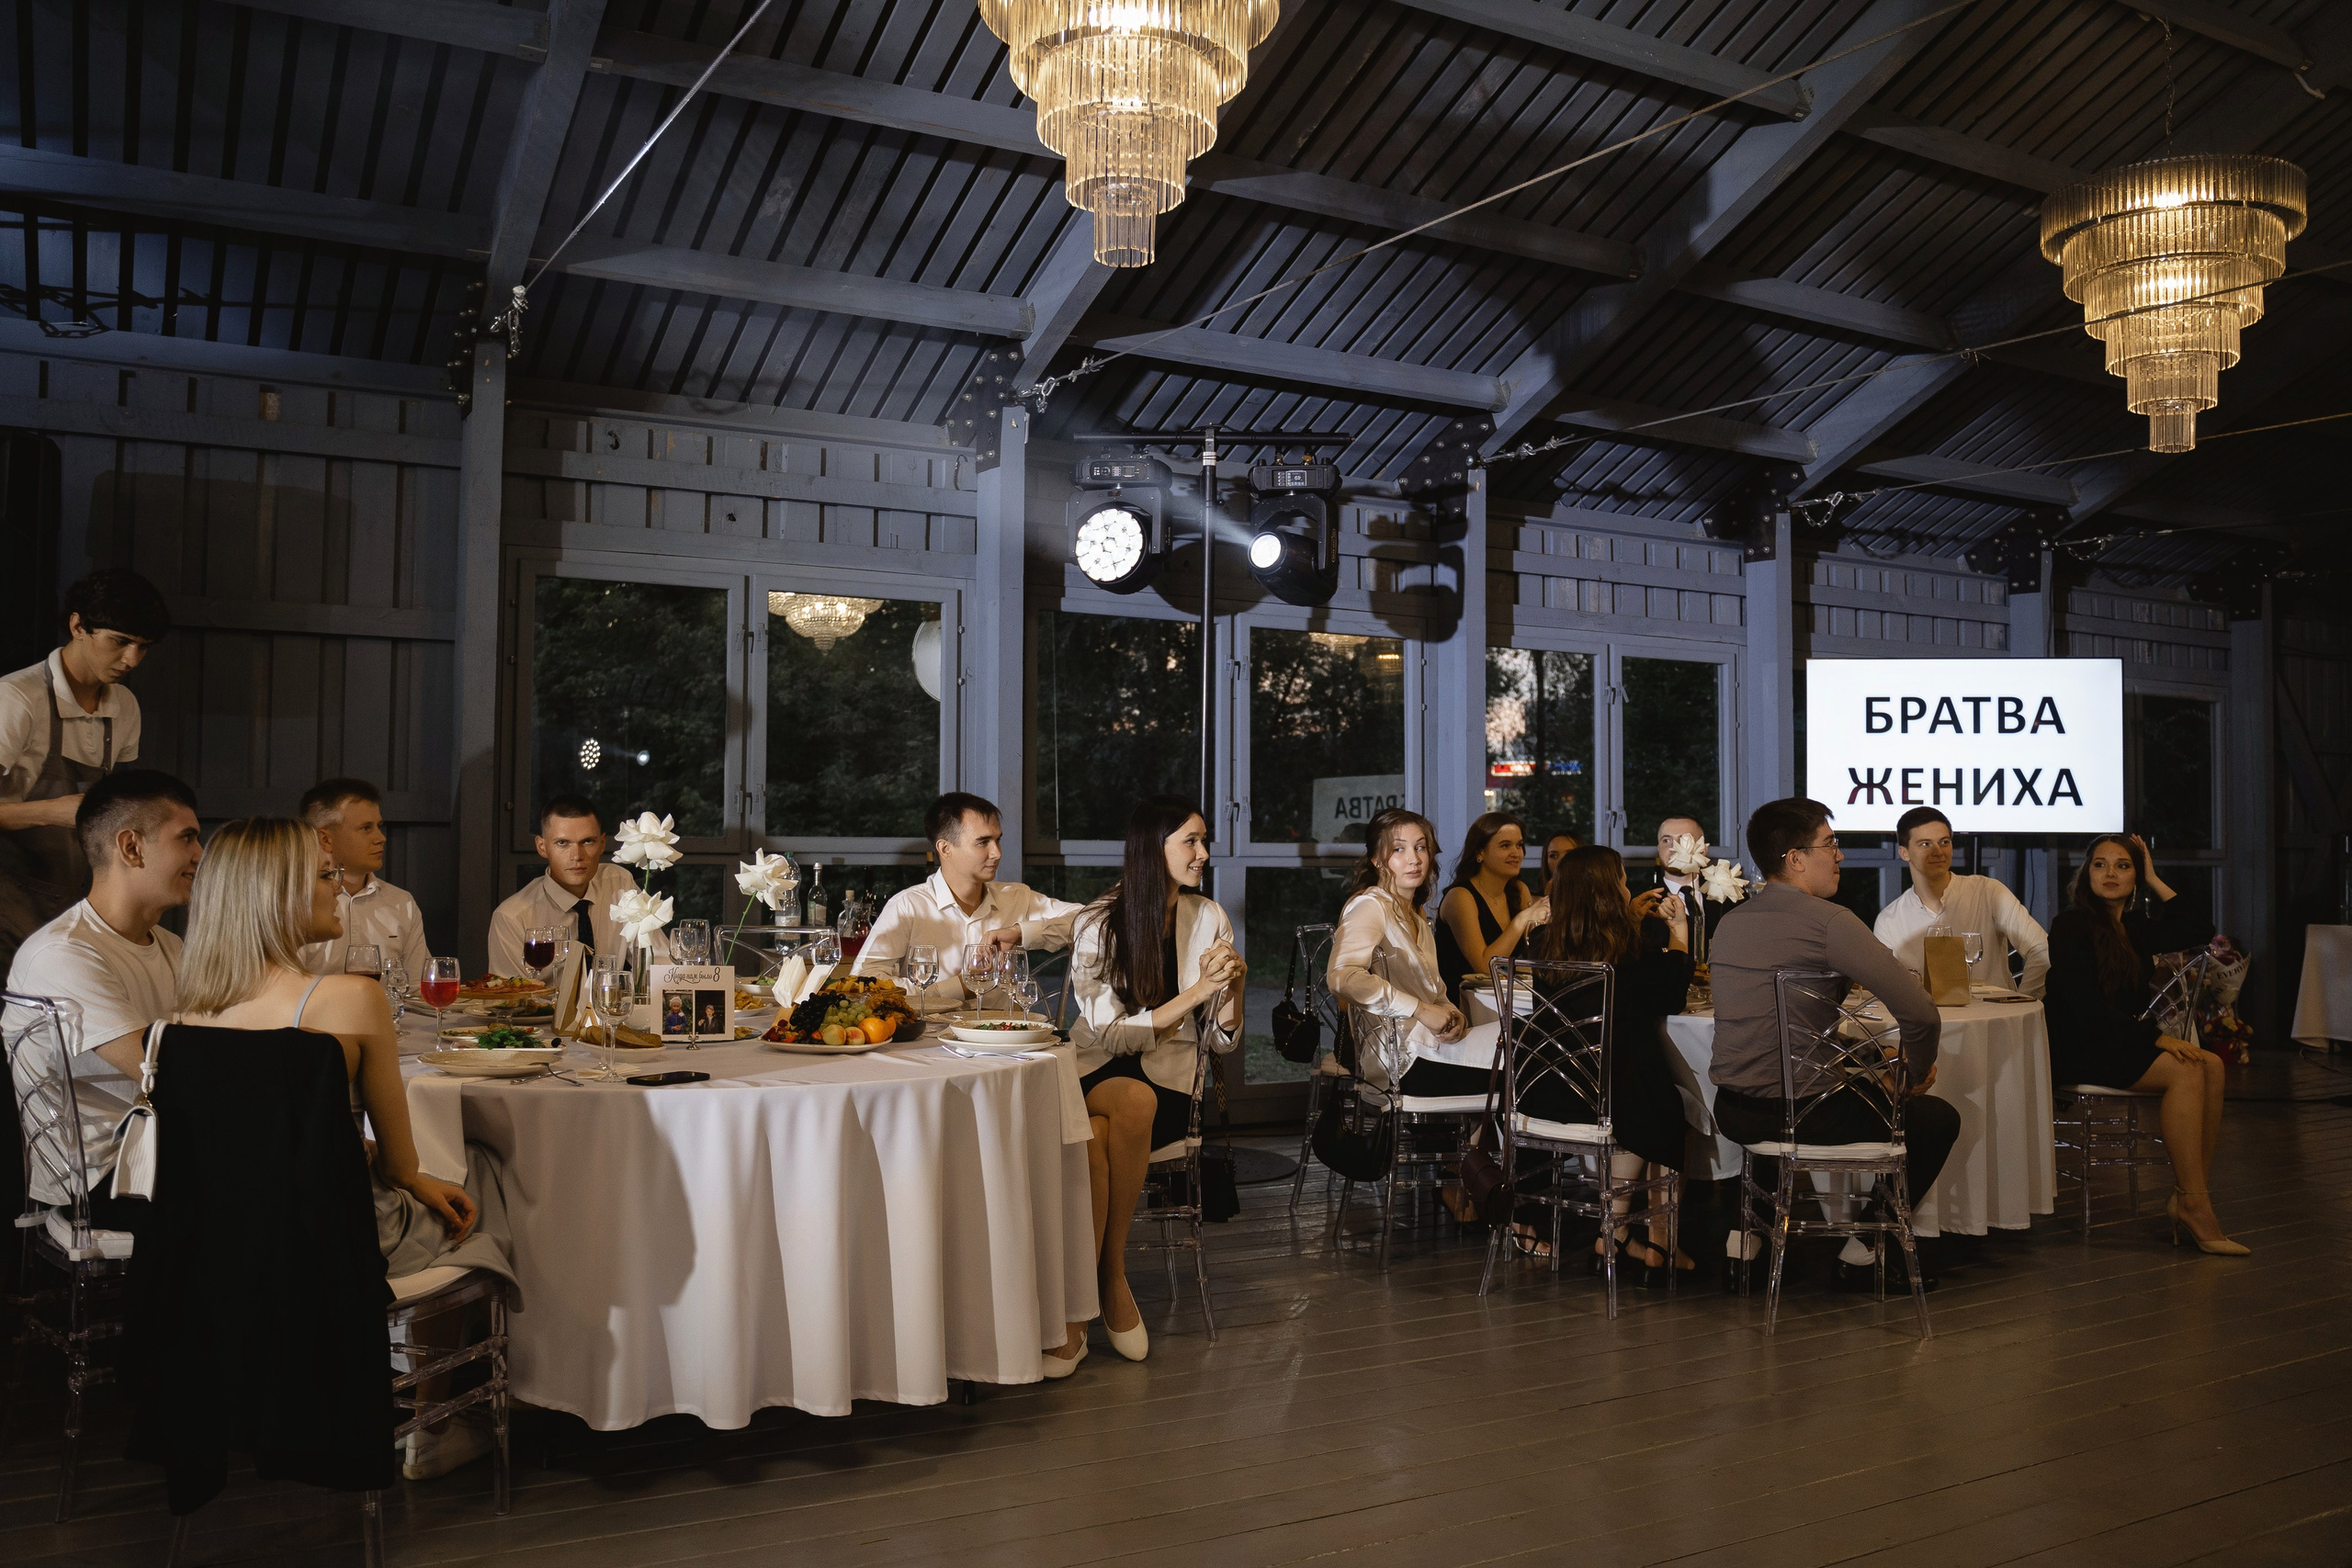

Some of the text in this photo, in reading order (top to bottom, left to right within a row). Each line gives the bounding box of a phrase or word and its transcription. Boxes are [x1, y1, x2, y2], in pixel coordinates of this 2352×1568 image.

[1866, 696, 2065, 734] БРАТВА
[1848, 768, 2084, 806] ЖЕНИХА
[663, 966, 685, 985] Когда
[712, 966, 721, 983] 8
